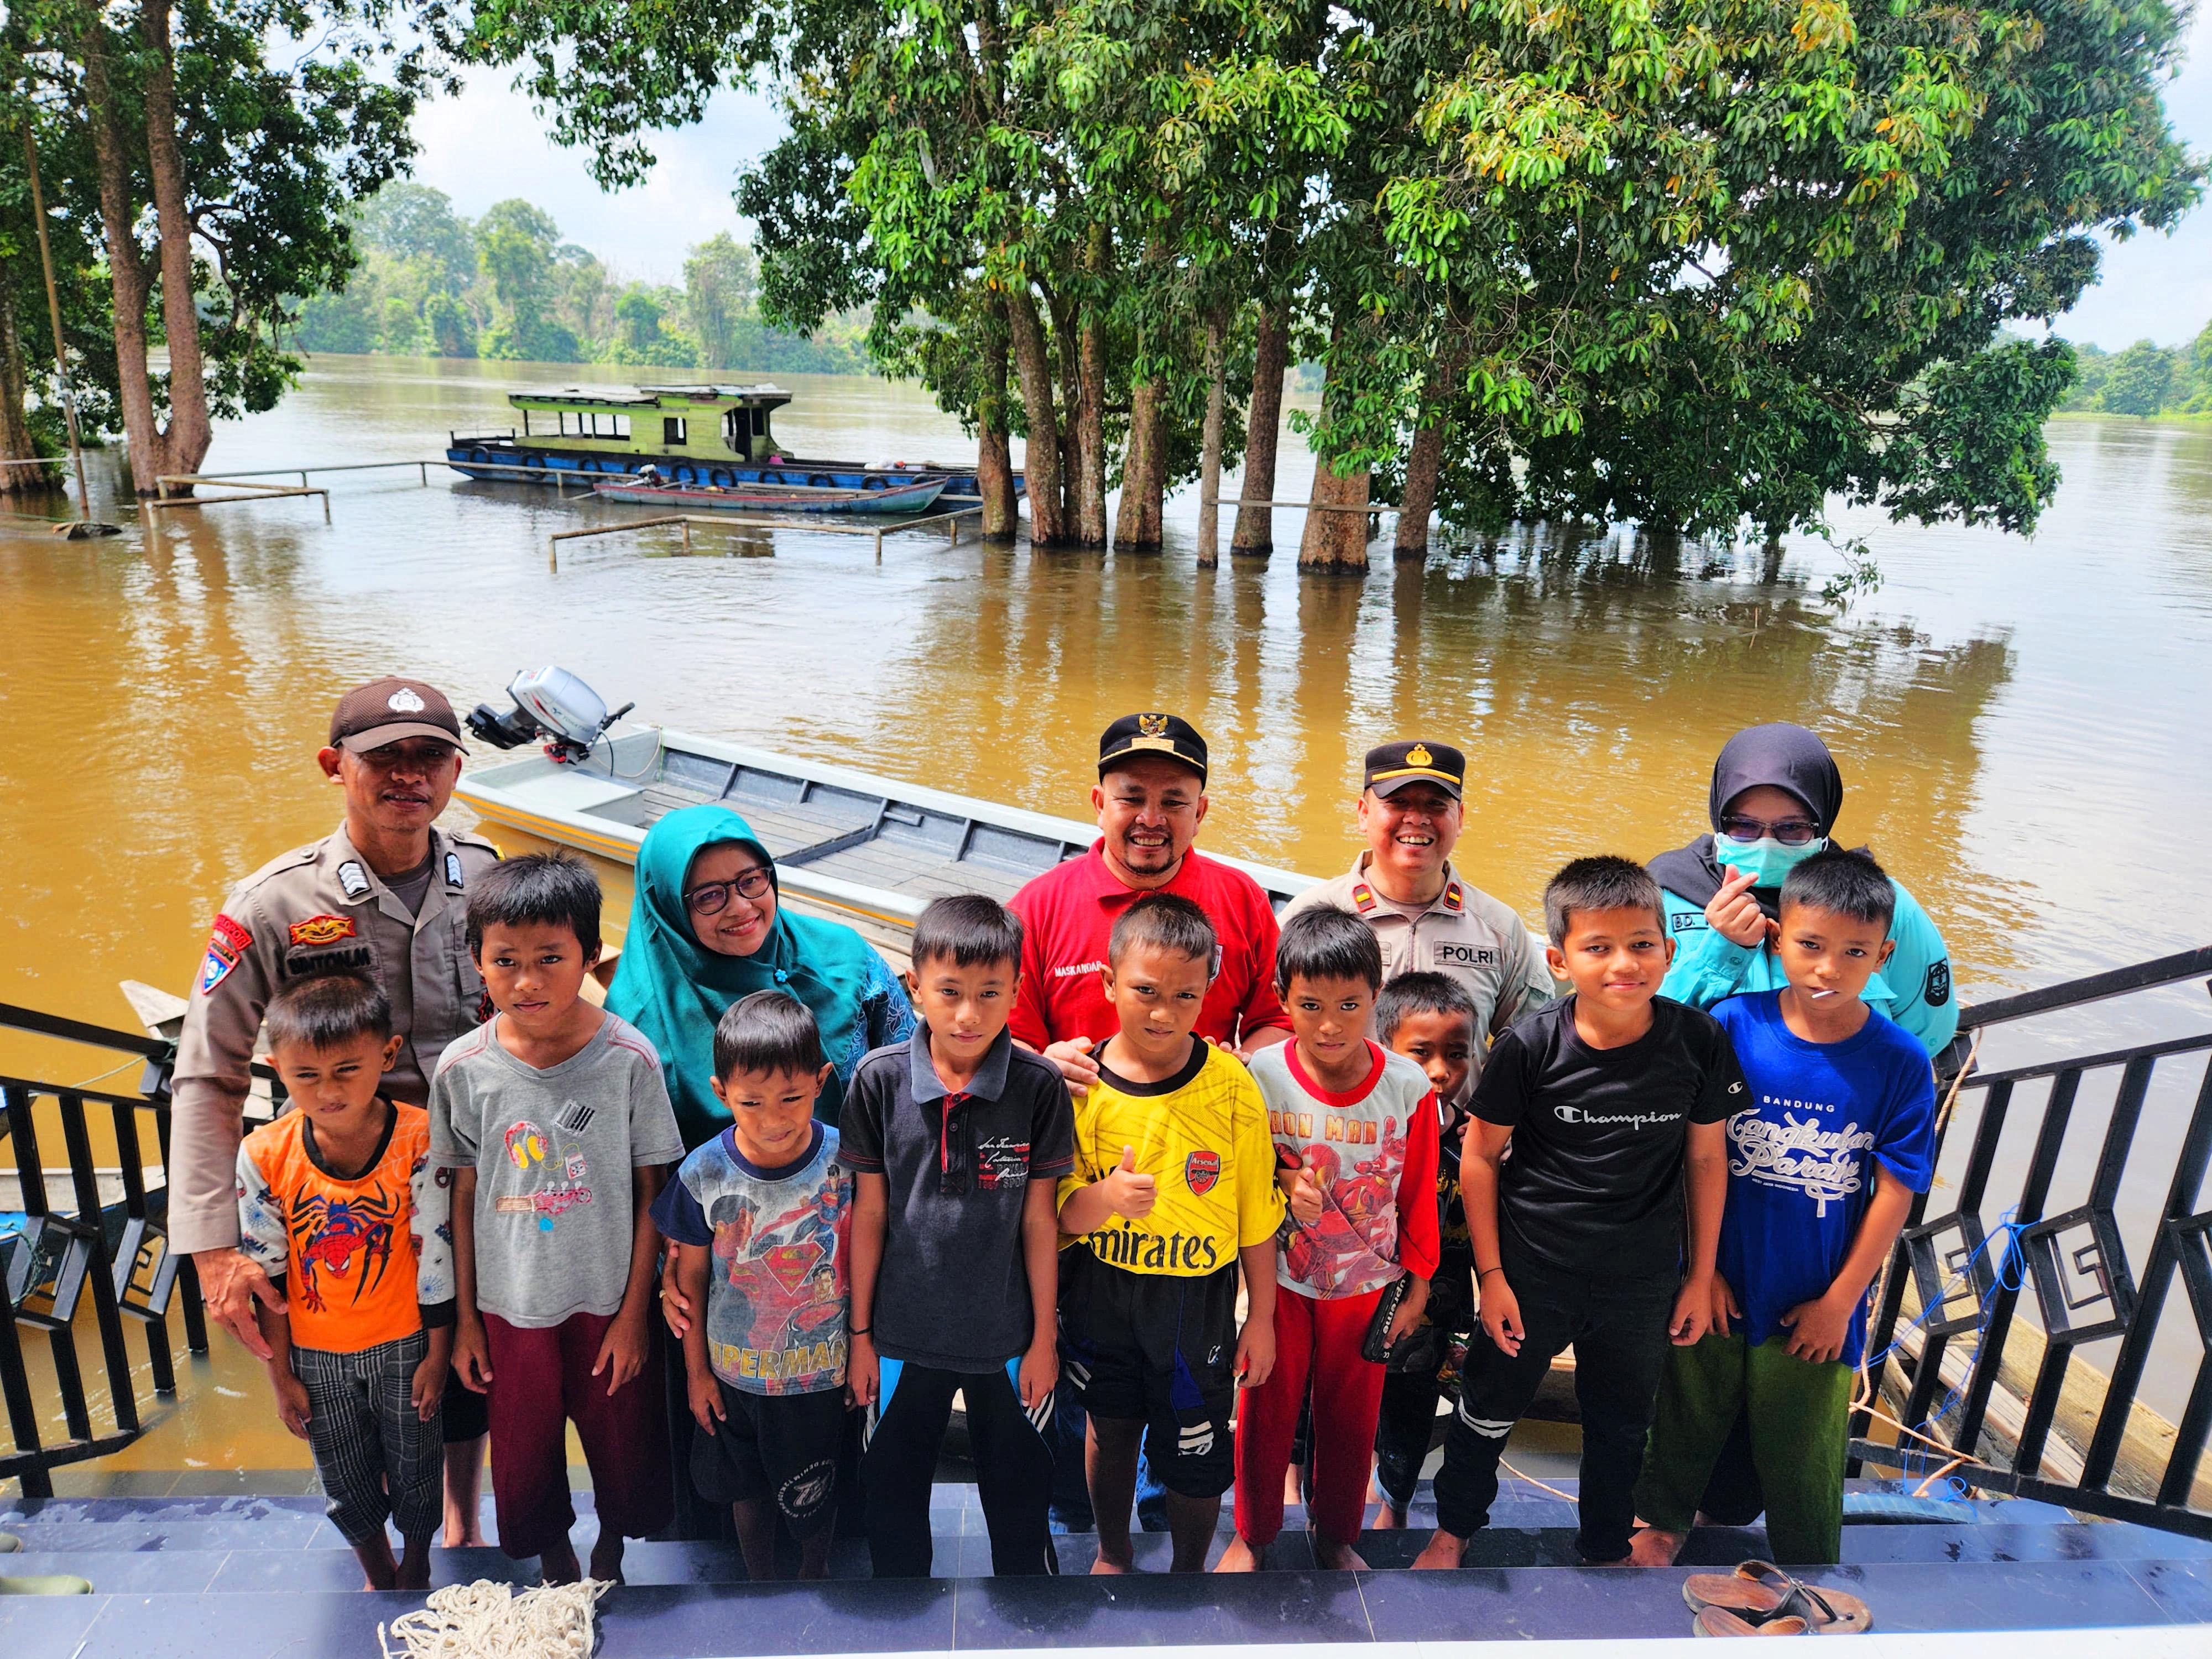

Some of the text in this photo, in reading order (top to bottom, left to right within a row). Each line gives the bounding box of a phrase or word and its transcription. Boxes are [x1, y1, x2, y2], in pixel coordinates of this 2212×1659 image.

[1443, 946, 1493, 964] POLRI
[1553, 1105, 1682, 1131] Champion
[1763, 1095, 1835, 1113] BANDUNG
[1267, 1110, 1377, 1145] RON MAN
[1191, 1156, 1219, 1166] Arsenal
[1088, 1220, 1217, 1270] mirates
[1383, 1279, 1406, 1334] upreme
[708, 1338, 847, 1379] UPERMAN
